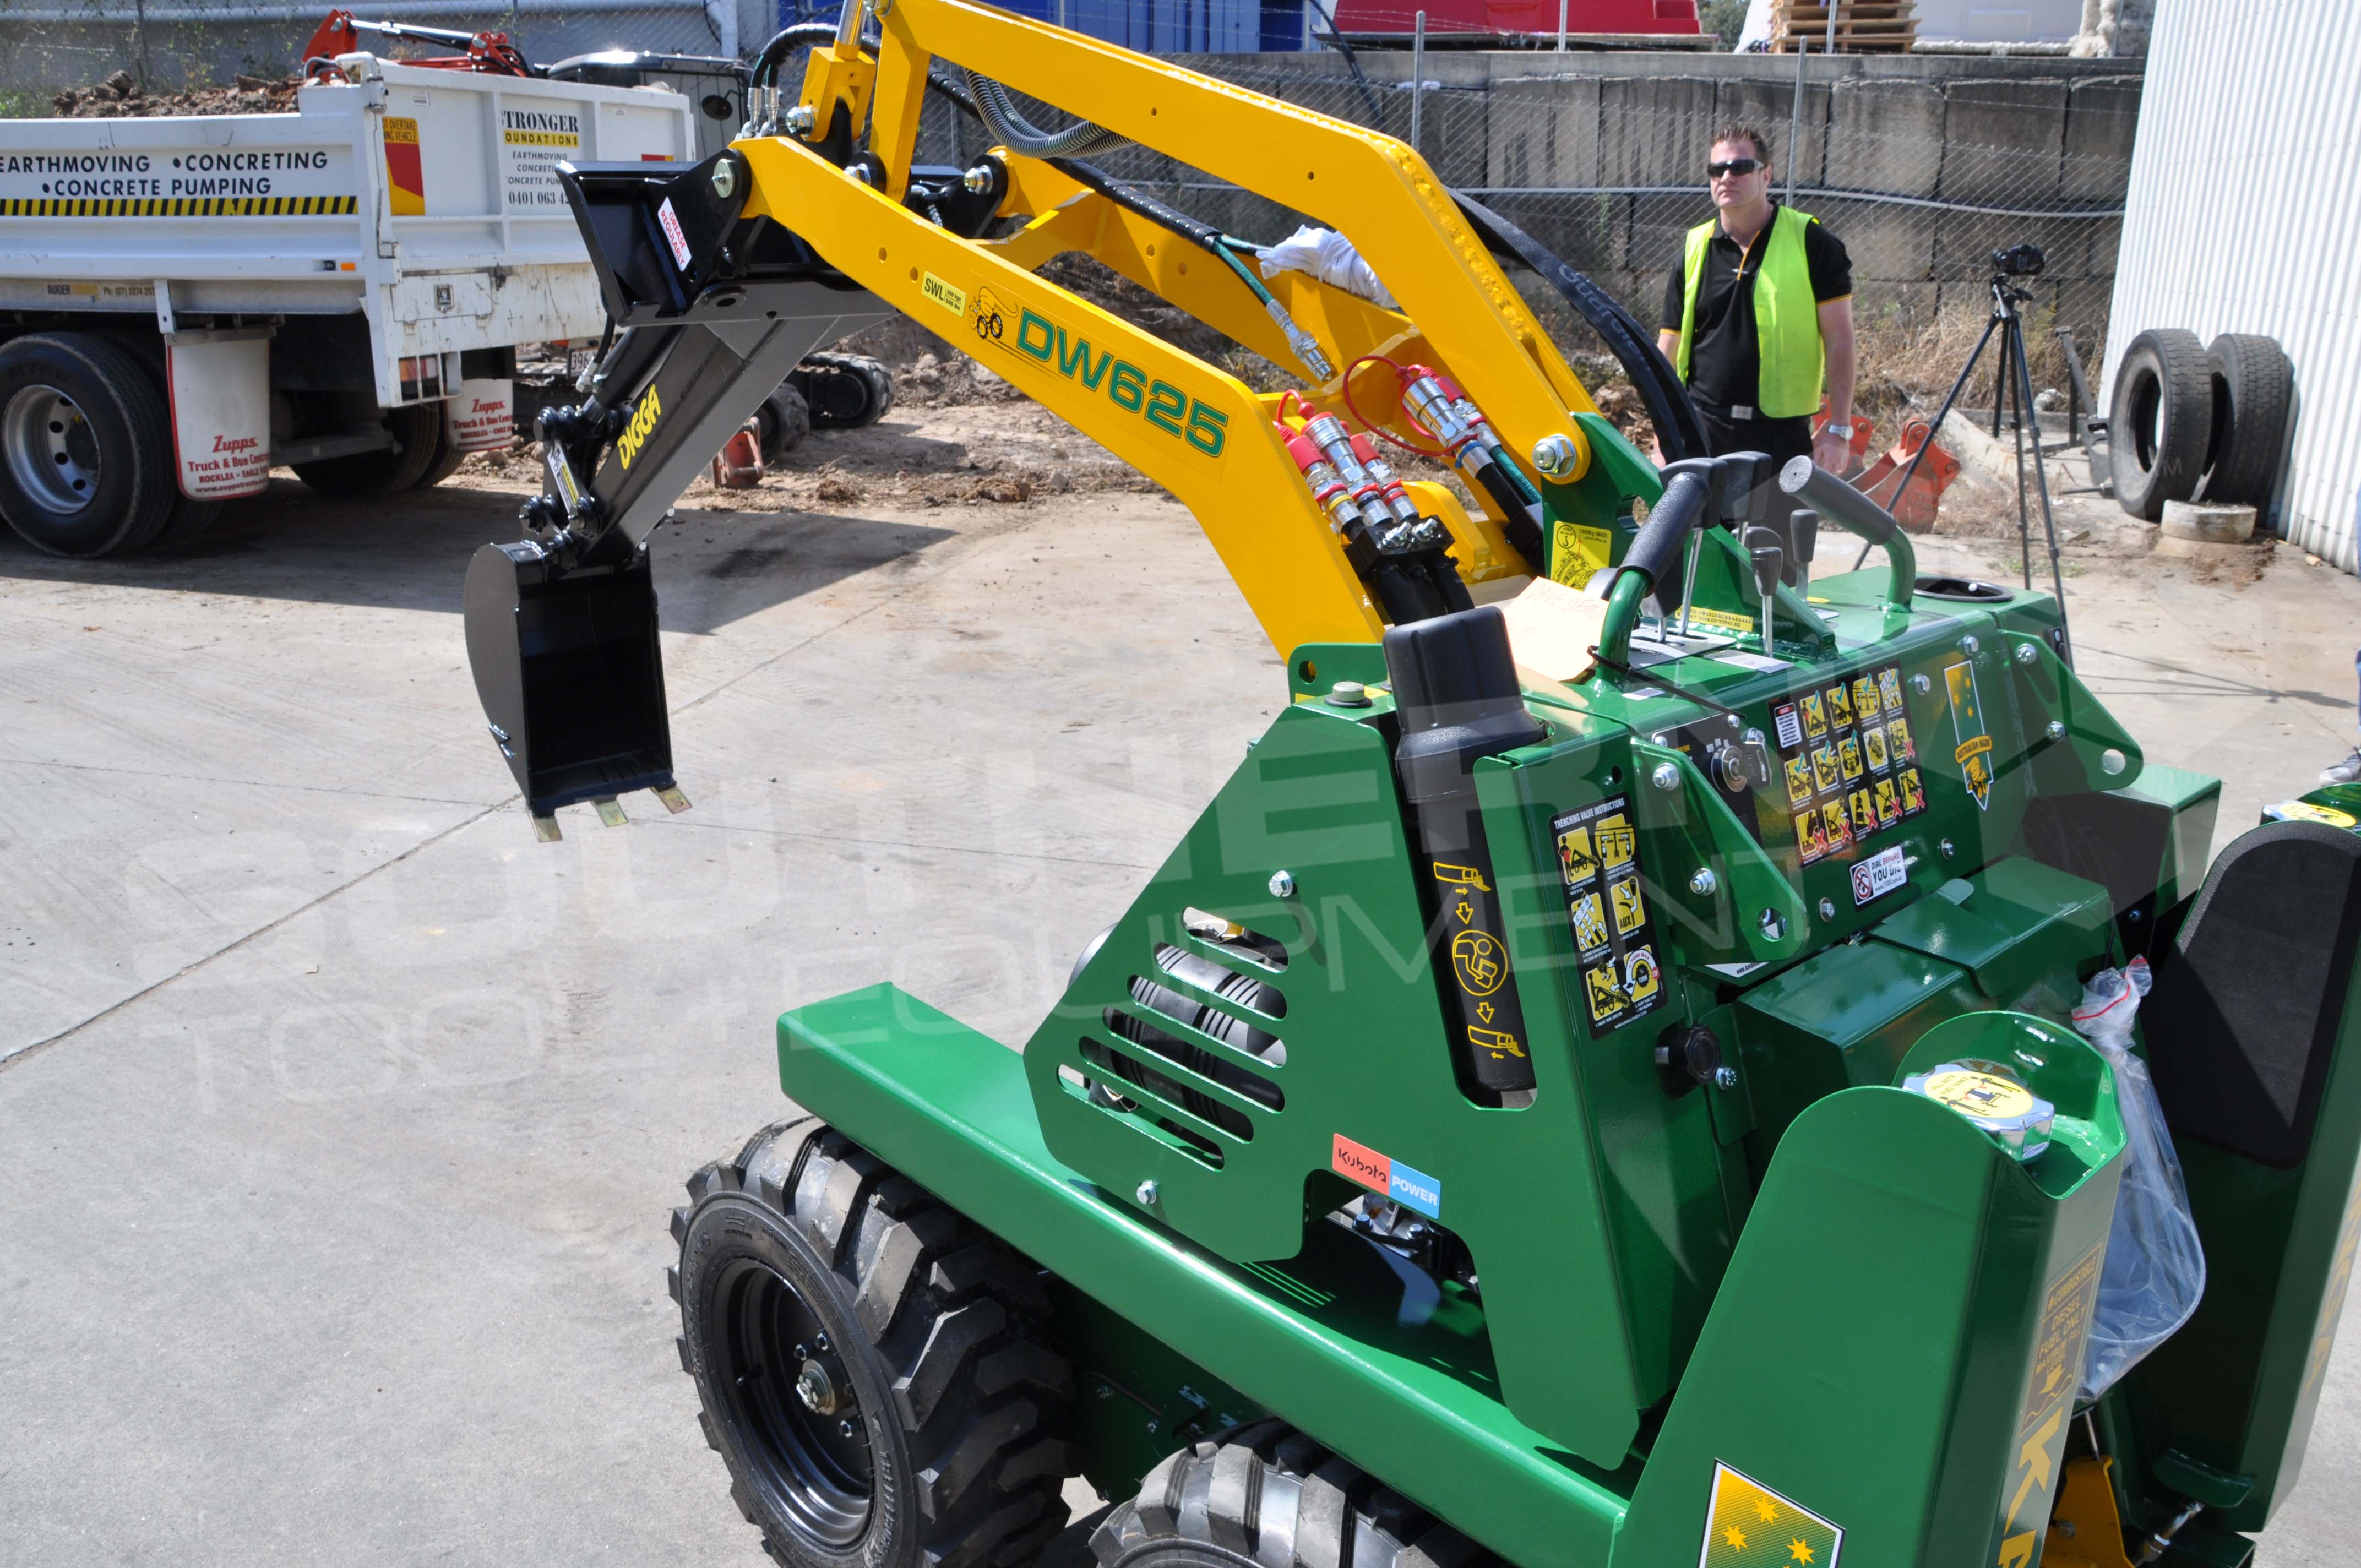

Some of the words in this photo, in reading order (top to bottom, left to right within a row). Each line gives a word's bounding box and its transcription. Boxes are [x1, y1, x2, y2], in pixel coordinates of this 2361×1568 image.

[505, 132, 578, 145] OUNDATIONS
[186, 151, 328, 171] CONCRETING
[513, 151, 568, 160] EARTHMOVING
[517, 164, 556, 172] CONCRETI
[55, 179, 160, 196] CONCRETE
[172, 178, 271, 195] PUMPING
[507, 177, 542, 185] ONCRETE
[509, 191, 534, 205] 0401
[661, 210, 684, 264] REGULARLY
[670, 211, 686, 249] GREASE
[924, 277, 944, 301] SWL
[1016, 307, 1229, 458] DW625
[472, 398, 505, 414] Zupps
[617, 384, 661, 470] DIGGA
[213, 434, 258, 455] Zupps
[188, 460, 220, 472] Truck
[223, 458, 231, 469] &
[232, 456, 248, 467] Bus
[199, 472, 235, 484] ROCKLEA
[1554, 813, 1581, 830] TRENCHING
[1580, 808, 1595, 821] VALVE
[1594, 797, 1625, 816] INSTRUCTIONS
[1872, 859, 1882, 870] DIAL
[1883, 851, 1900, 865] BEFORE
[1873, 867, 1887, 884] YOU
[1620, 914, 1632, 928] AUX
[1338, 1147, 1387, 1183] Kubota
[1392, 1175, 1438, 1206] POWER
[2052, 1295, 2081, 1331] DIESEL
[2038, 1330, 2060, 1359] FUEL
[2064, 1303, 2088, 1336] ONLY
